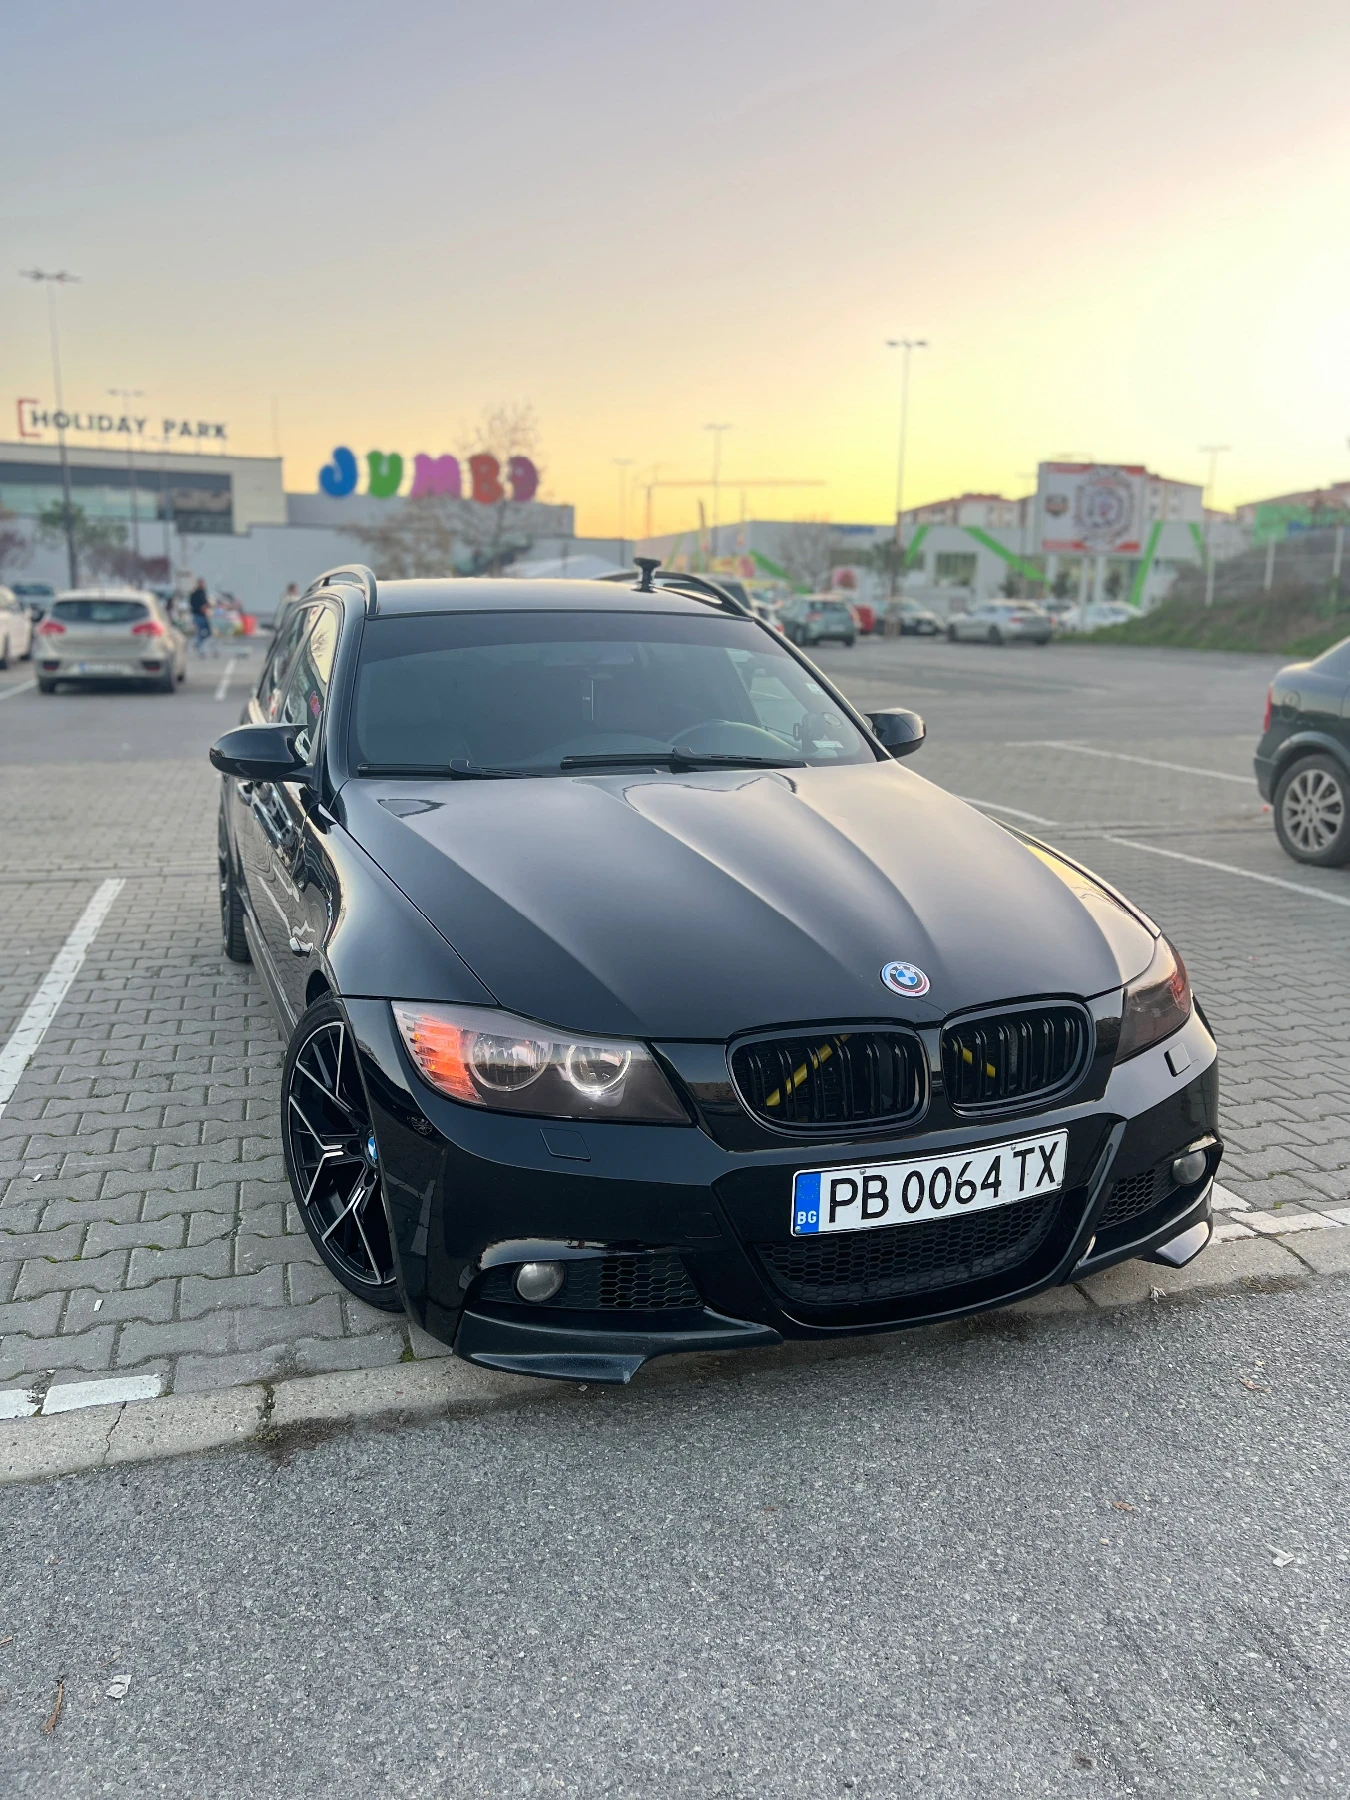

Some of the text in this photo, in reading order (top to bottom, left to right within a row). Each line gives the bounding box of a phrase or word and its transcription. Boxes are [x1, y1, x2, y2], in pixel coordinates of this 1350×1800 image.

[31, 410, 227, 439] HOLIDAY PARK
[828, 1140, 1060, 1224] PB 0064 TX
[797, 1211, 817, 1225] BG
